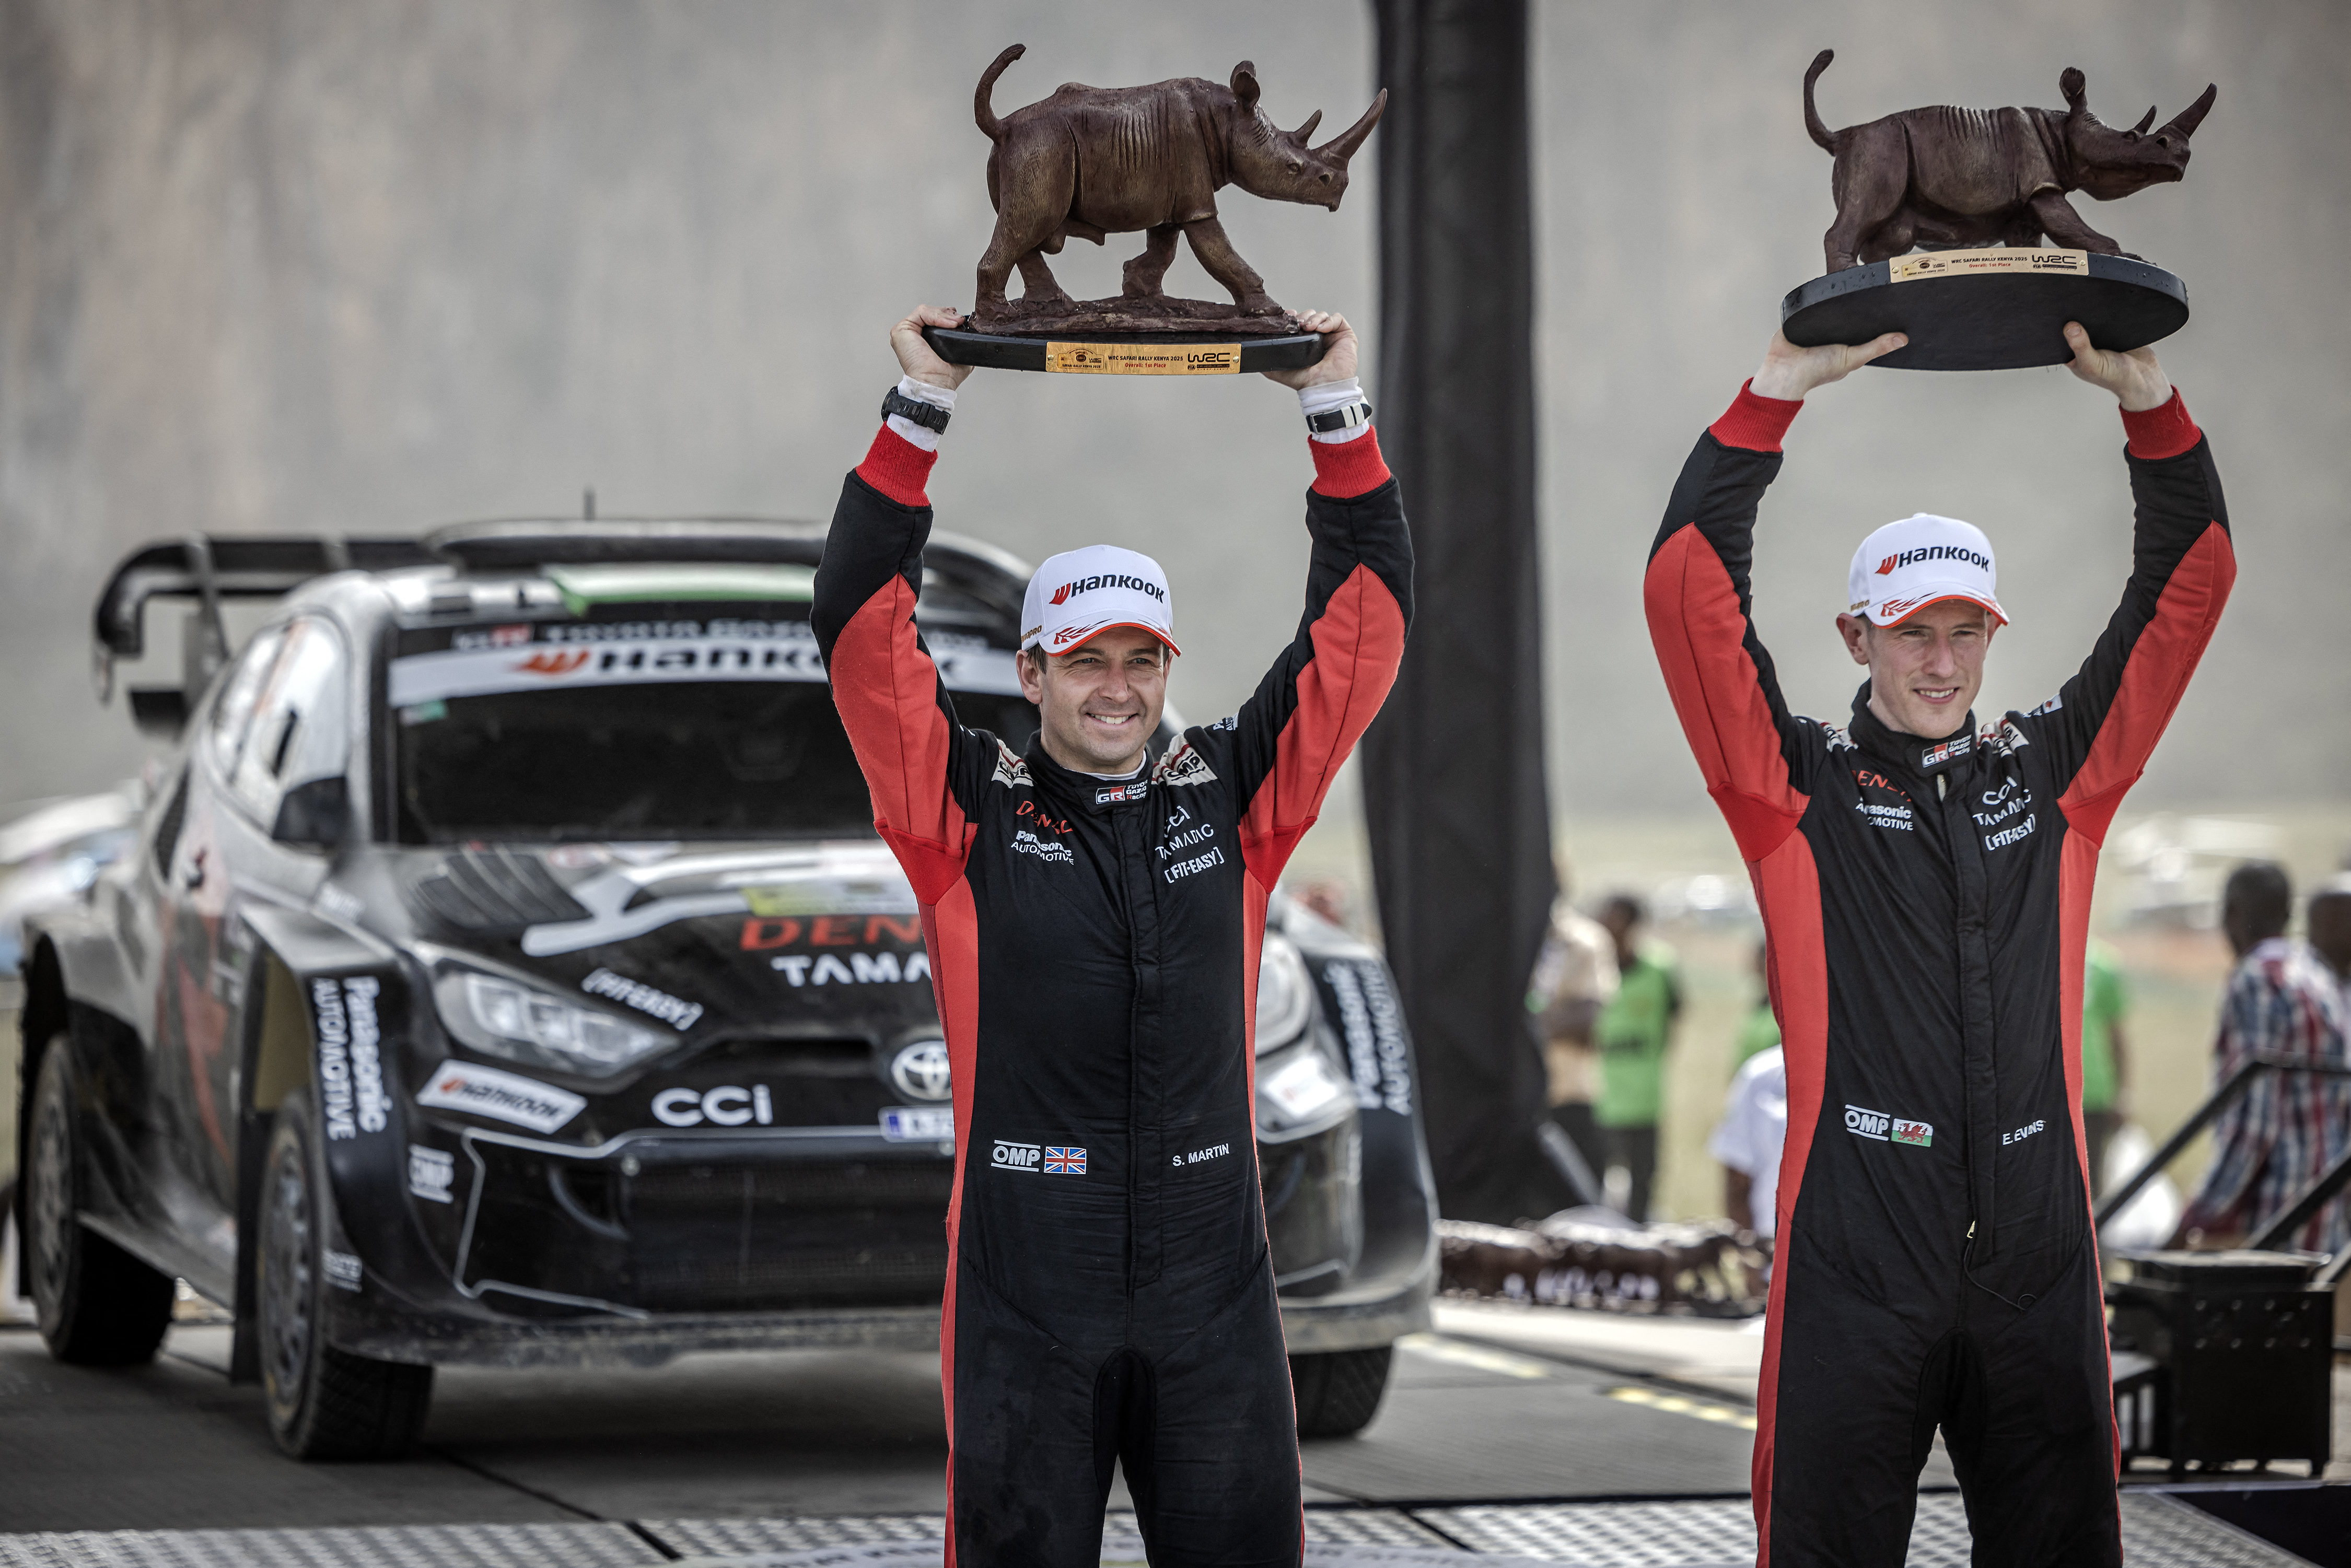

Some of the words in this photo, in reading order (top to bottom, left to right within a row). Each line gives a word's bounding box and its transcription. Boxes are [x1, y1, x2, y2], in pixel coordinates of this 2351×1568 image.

[2032, 254, 2077, 264] WRC
[1188, 353, 1230, 362] WRC
[1924, 750, 1947, 766] GR
[1098, 791, 1123, 803] GR
[1011, 841, 1074, 865] AUTOMOTIVE
[739, 915, 923, 951] DEN
[770, 951, 932, 988] TAMA
[1845, 1110, 1889, 1134] OMP
[993, 1145, 1041, 1166] OMP
[1172, 1155, 1185, 1166] S.
[1188, 1143, 1230, 1164] MARTIN
